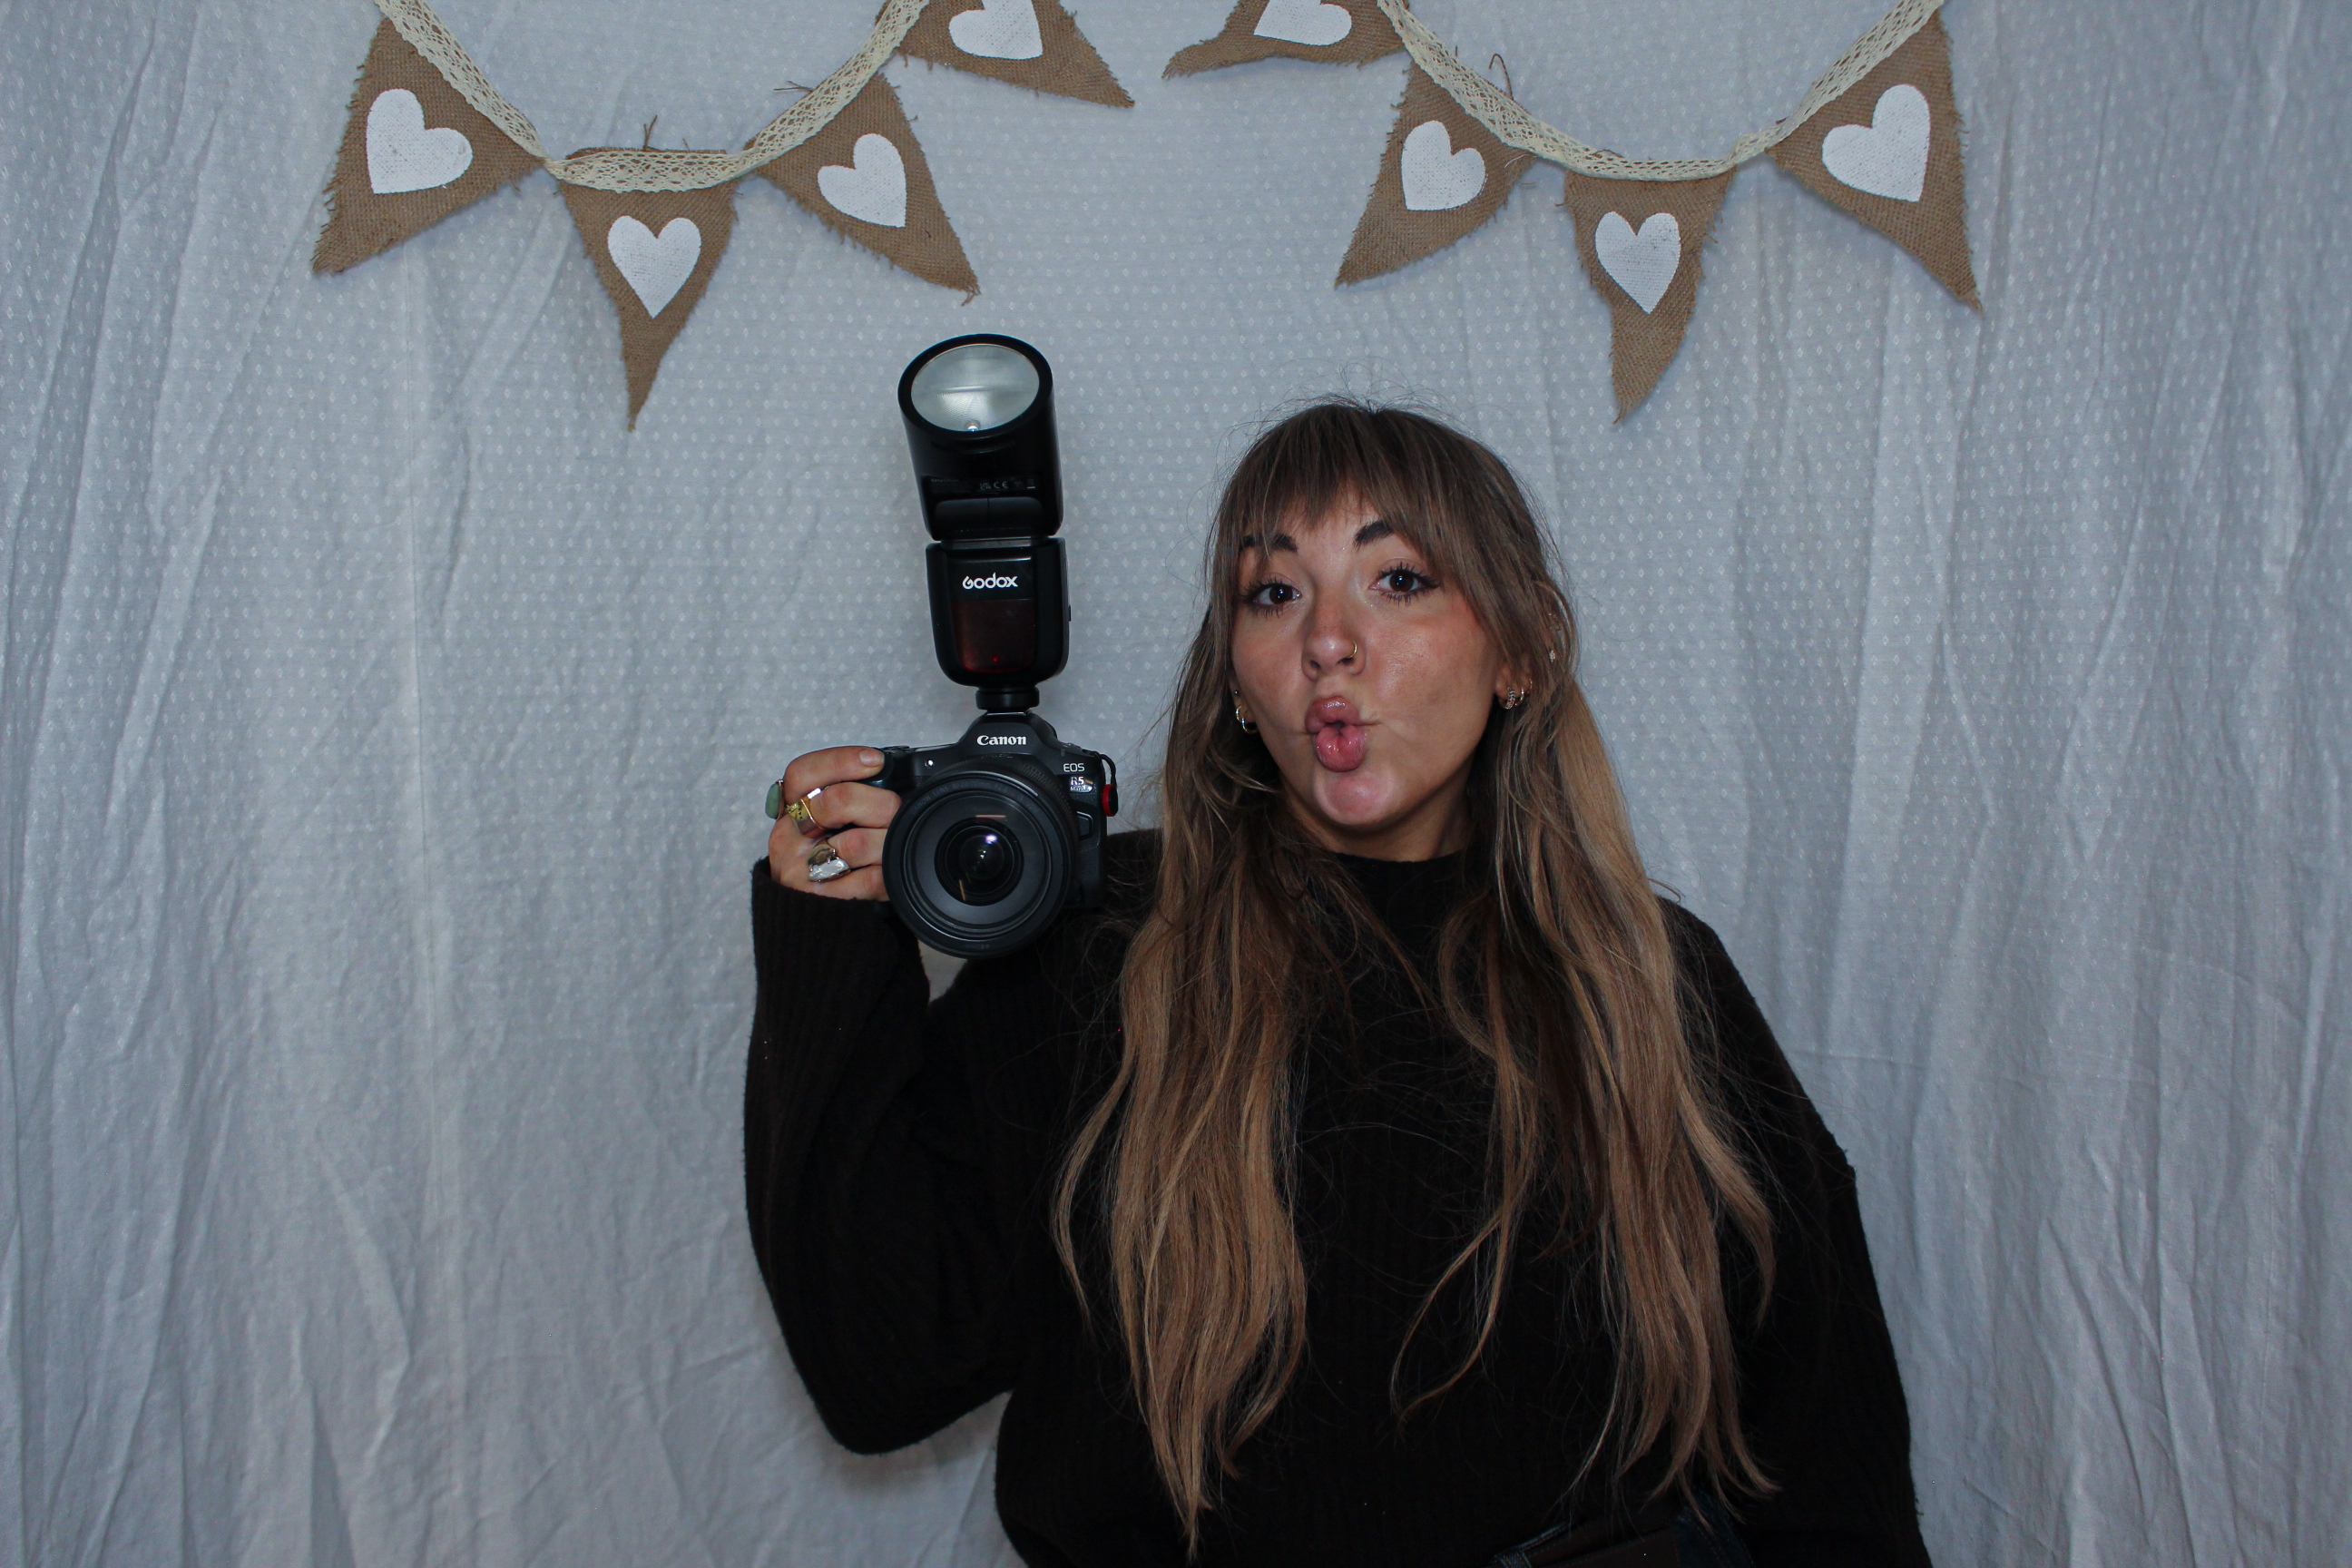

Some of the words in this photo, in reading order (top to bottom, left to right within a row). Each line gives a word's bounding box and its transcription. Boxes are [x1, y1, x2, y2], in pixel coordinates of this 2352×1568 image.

[962, 572, 1018, 589] Godox
[976, 735, 1026, 745] Canon
[1063, 763, 1085, 772] EOS
[1070, 776, 1084, 785] R5
